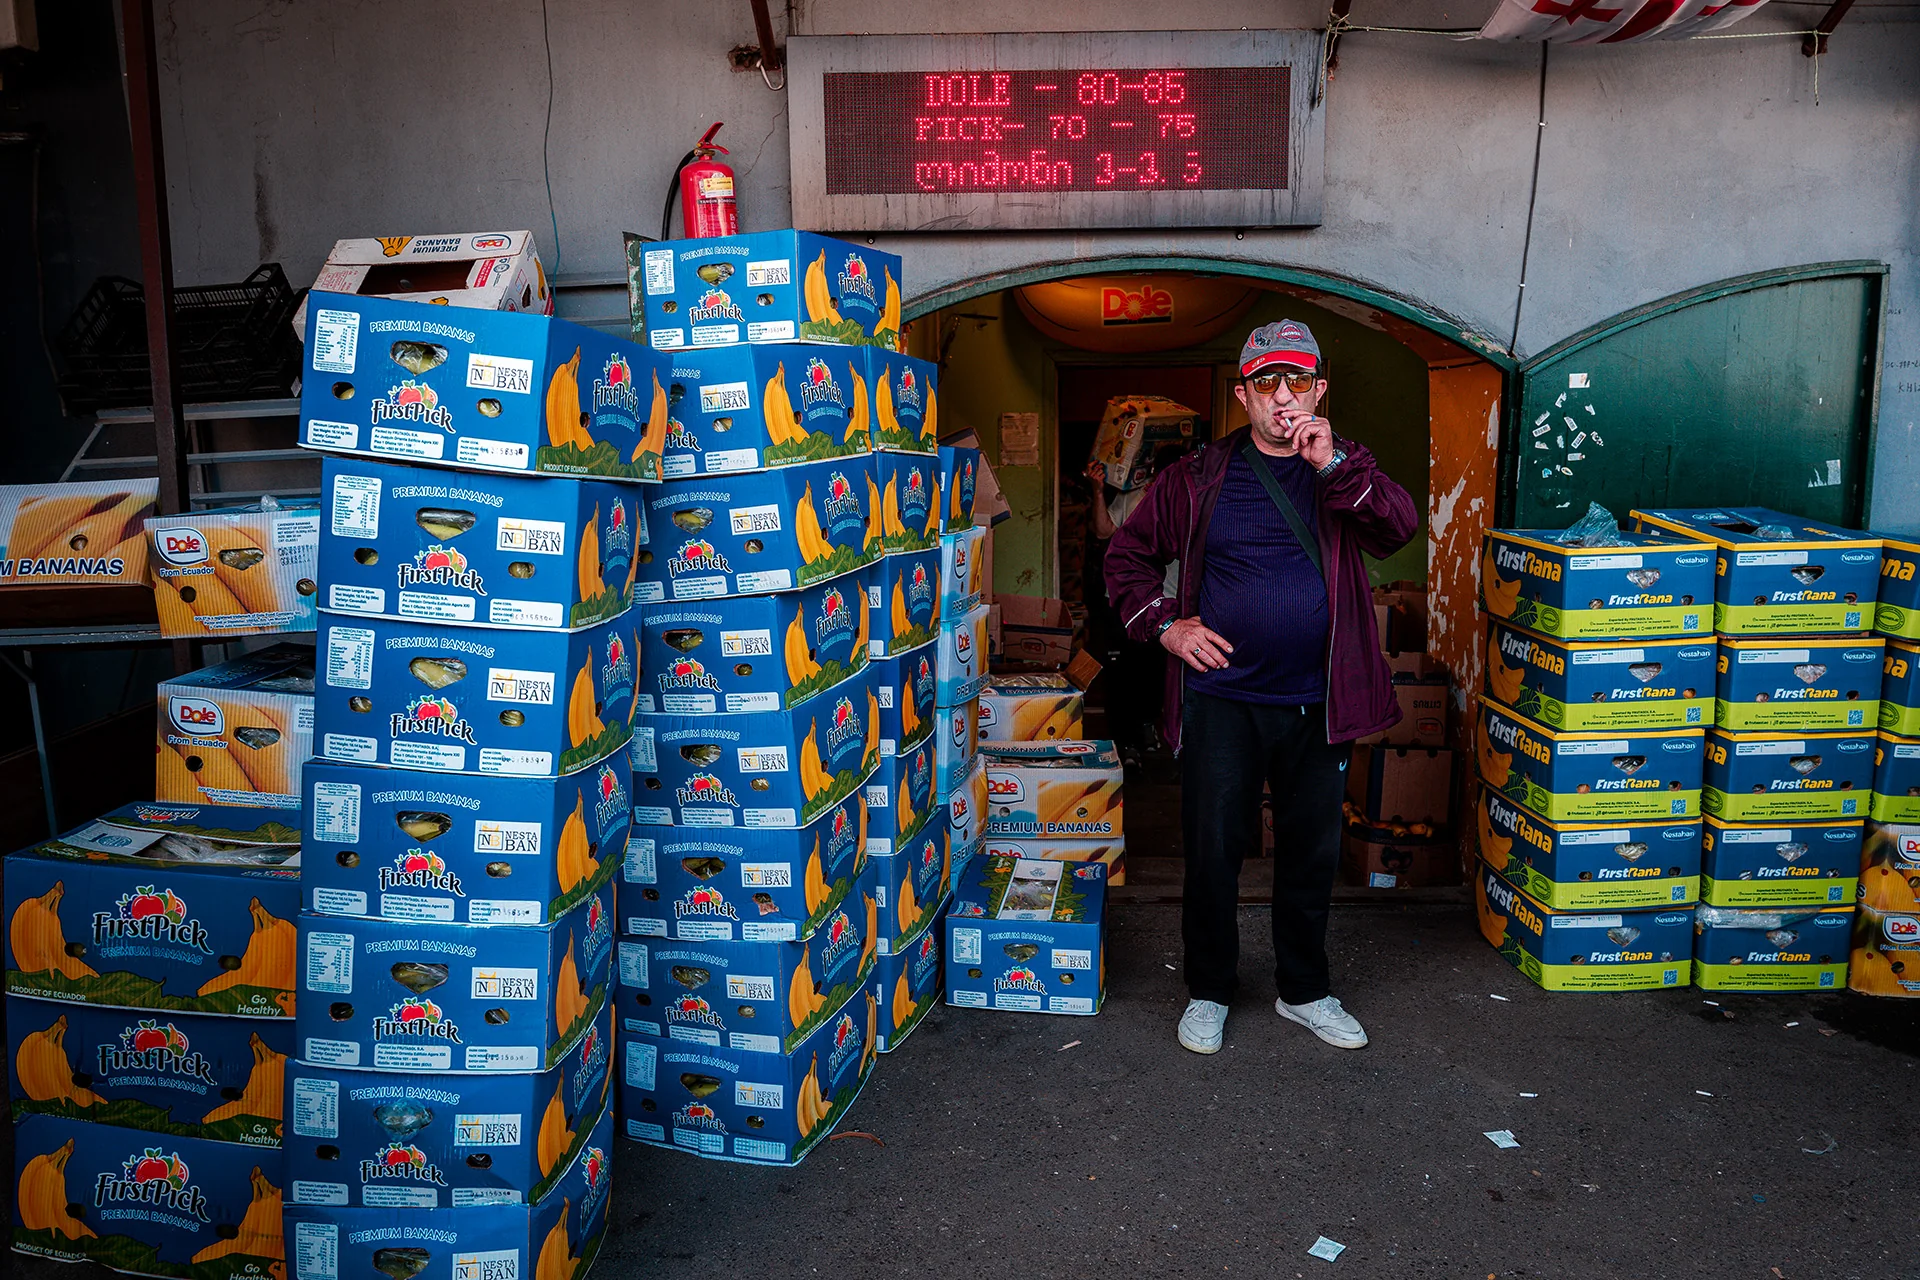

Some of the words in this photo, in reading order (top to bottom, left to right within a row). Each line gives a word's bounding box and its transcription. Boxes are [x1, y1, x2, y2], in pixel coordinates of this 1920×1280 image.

[925, 75, 1010, 106] DOLE
[1050, 115, 1086, 139] 70
[1160, 114, 1195, 138] 75
[413, 244, 458, 253] PREMIUM
[416, 238, 461, 246] BANANAS
[680, 247, 713, 261] PREMIUM
[714, 247, 749, 256] BANANAS
[766, 267, 788, 275] NESTA
[766, 274, 788, 283] BAN
[1103, 285, 1172, 321] Dole
[689, 304, 745, 325] FirstPick
[370, 320, 421, 333] PREMIUM
[423, 322, 475, 344] BANANAS
[497, 366, 529, 380] NESTA
[497, 378, 529, 391] BAN
[722, 390, 746, 401] NESTA
[723, 397, 747, 409] BAN
[371, 399, 456, 433] FirstPick
[393, 487, 448, 498] PREMIUM
[449, 488, 503, 507] BANANAS
[652, 494, 688, 510] PREMIUM
[689, 492, 730, 502] BANANAS
[752, 512, 776, 521] NESTA
[754, 520, 778, 531] BAN
[528, 530, 561, 542] NESTA
[166, 536, 200, 552] Dole
[528, 540, 560, 552] BAN
[18, 558, 124, 576] BANANAS
[160, 569, 180, 577] From
[182, 567, 215, 576] Ecuador
[668, 556, 733, 578] FirstPick
[398, 562, 487, 596] FirstPick
[644, 615, 682, 626] PREMIUM
[683, 612, 722, 624] BANANAS
[744, 636, 768, 645] NESTA
[386, 638, 438, 650] PREMIUM
[440, 638, 495, 658] BANANAS
[744, 644, 769, 654] BAN
[519, 679, 551, 690] NESTA
[658, 673, 722, 692] FirstPick
[518, 689, 550, 701] BAN
[1413, 700, 1441, 708] CITRUS
[180, 705, 216, 722] Dole
[390, 713, 477, 745] FirstPick
[662, 729, 699, 742] PREMIUM
[701, 729, 740, 741] BANANAS
[167, 735, 190, 747] From
[192, 736, 228, 749] Ecuador
[761, 754, 784, 763] NESTA
[761, 761, 786, 770] BAN
[372, 791, 425, 804] PREMIUM
[426, 791, 480, 810] BANANAS
[676, 787, 740, 807] FirstPick
[1046, 823, 1112, 833] BANANAS
[506, 830, 538, 841] NESTA
[505, 840, 537, 851] BAN
[663, 842, 702, 854] PREMIUM
[703, 842, 744, 856] BANANAS
[764, 870, 788, 878] NESTA
[764, 876, 788, 885] BAN
[378, 867, 466, 897] FirstPick
[674, 900, 740, 920] FirstPick
[93, 912, 214, 955] FirstPick
[1892, 923, 1917, 934] Dole
[100, 945, 150, 959] PREMIUM
[152, 946, 203, 966] BANANAS
[366, 940, 420, 953] PREMIUM
[421, 941, 476, 958] BANANAS
[655, 951, 691, 962] PREMIUM
[693, 951, 728, 967] BANANAS
[502, 977, 535, 987] NESTA
[748, 983, 772, 992] NESTA
[11, 985, 36, 996] PRODUCT
[37, 988, 51, 998] OF
[52, 990, 87, 1002] ECUADOR
[502, 986, 534, 998] BAN
[749, 990, 772, 999] BAN
[251, 994, 267, 1005] Go
[237, 1003, 281, 1017] Healthy
[665, 1006, 726, 1030] FirstPick
[373, 1016, 463, 1044] FirstPick
[98, 1044, 217, 1086] FirstPick
[664, 1053, 700, 1064] PREMIUM
[701, 1056, 739, 1073] BANANAS
[109, 1076, 157, 1088] PREMIUM
[158, 1078, 207, 1096] BANANAS
[350, 1087, 405, 1100] PREMIUM
[405, 1088, 460, 1105] BANANAS
[757, 1090, 781, 1099] NESTA
[757, 1097, 780, 1108] BAN
[252, 1124, 268, 1135] Go
[486, 1123, 518, 1133] NESTA
[240, 1133, 281, 1147] Healthy
[485, 1132, 517, 1143] BAN
[360, 1159, 448, 1186] FirstPick
[95, 1173, 211, 1223] FirstPick
[101, 1209, 147, 1222] PREMIUM
[148, 1212, 200, 1233] BANANAS
[349, 1229, 402, 1244] PREMIUM
[403, 1228, 457, 1244] BANANAS
[245, 1263, 260, 1273] Go
[483, 1259, 515, 1269] NESTA
[482, 1267, 515, 1280] BAN
